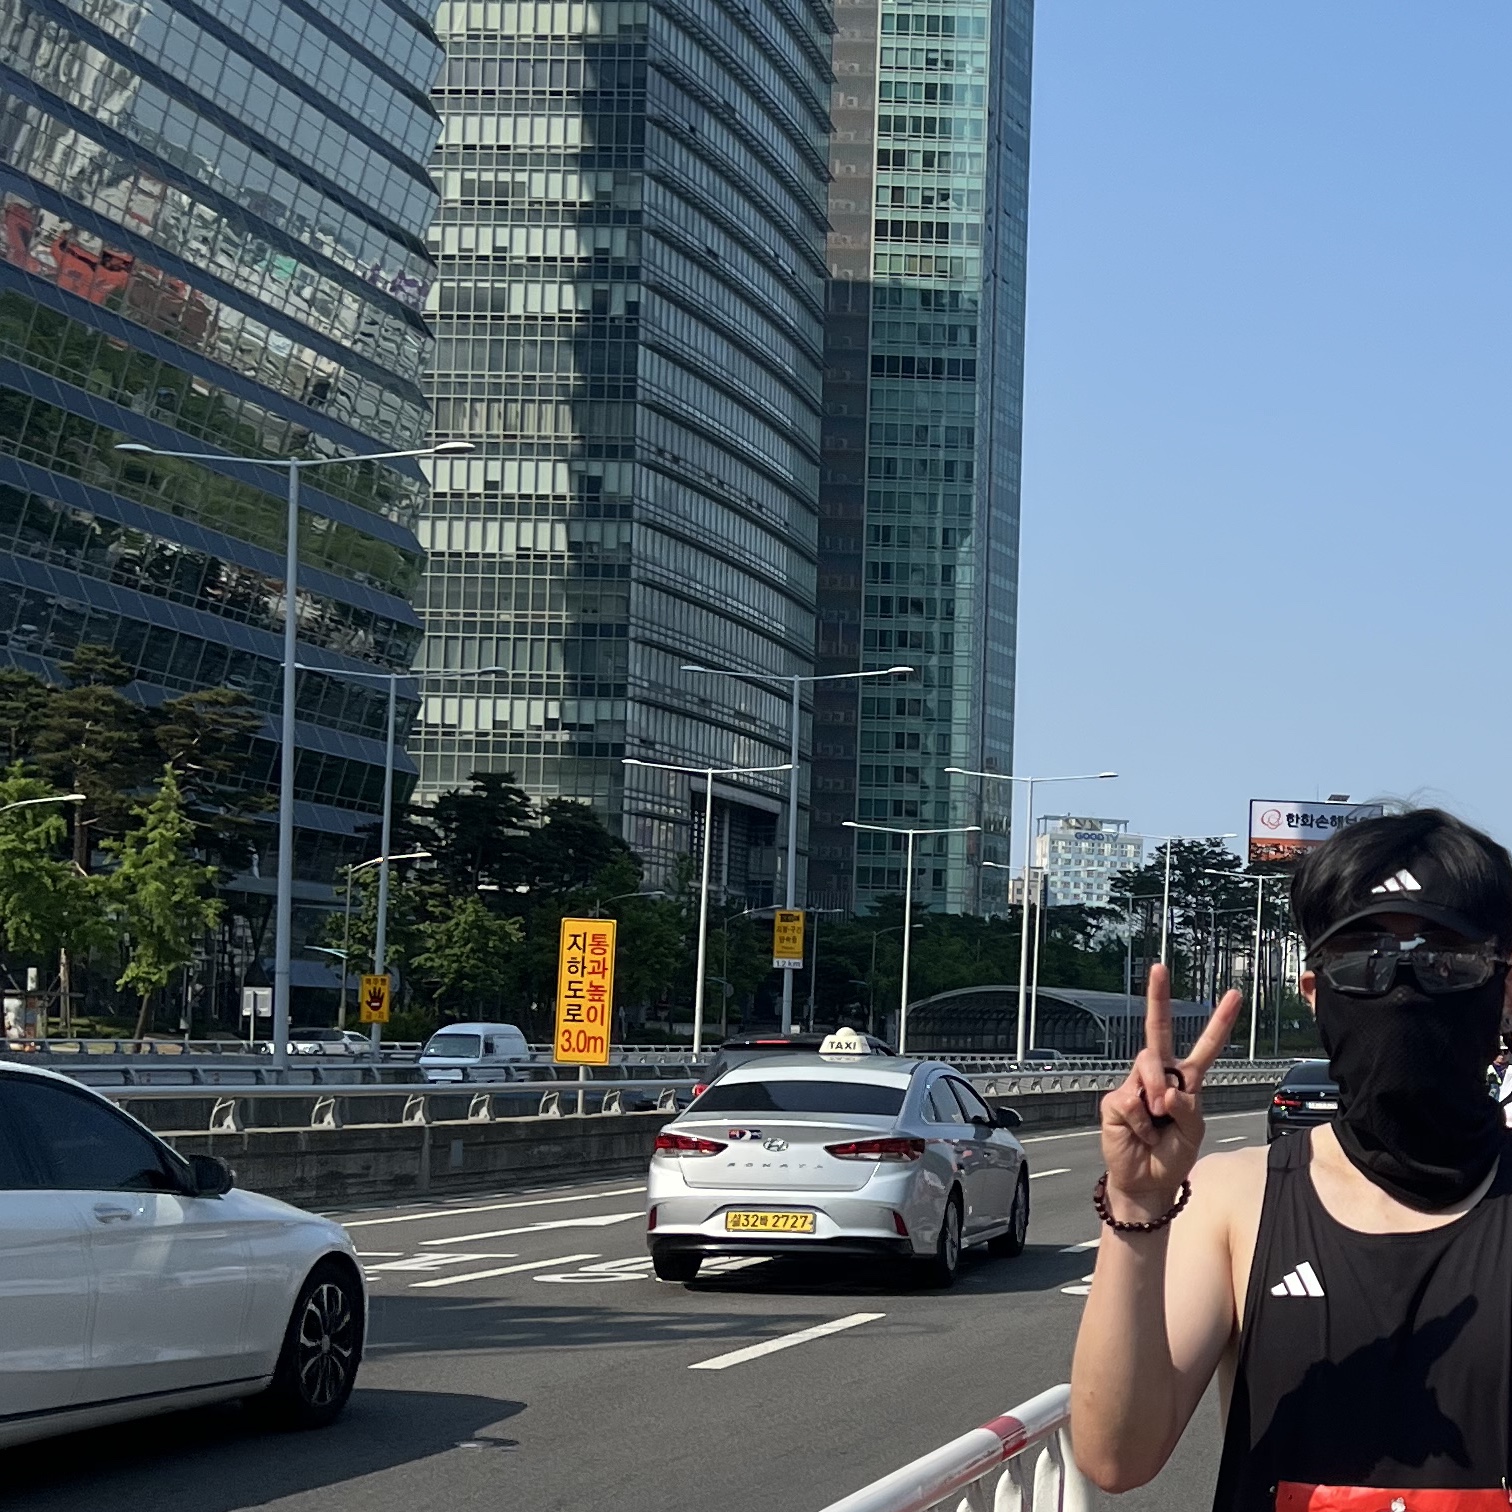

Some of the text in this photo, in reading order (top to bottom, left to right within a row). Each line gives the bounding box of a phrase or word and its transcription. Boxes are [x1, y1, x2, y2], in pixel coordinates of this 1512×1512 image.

[1074, 832, 1119, 843] GOOD TV
[562, 931, 587, 1023] 지하도로
[585, 933, 609, 1027] 통과높이
[560, 1029, 604, 1054] 3.0m
[829, 1041, 857, 1050] TAXI
[771, 1214, 809, 1229] 2727
